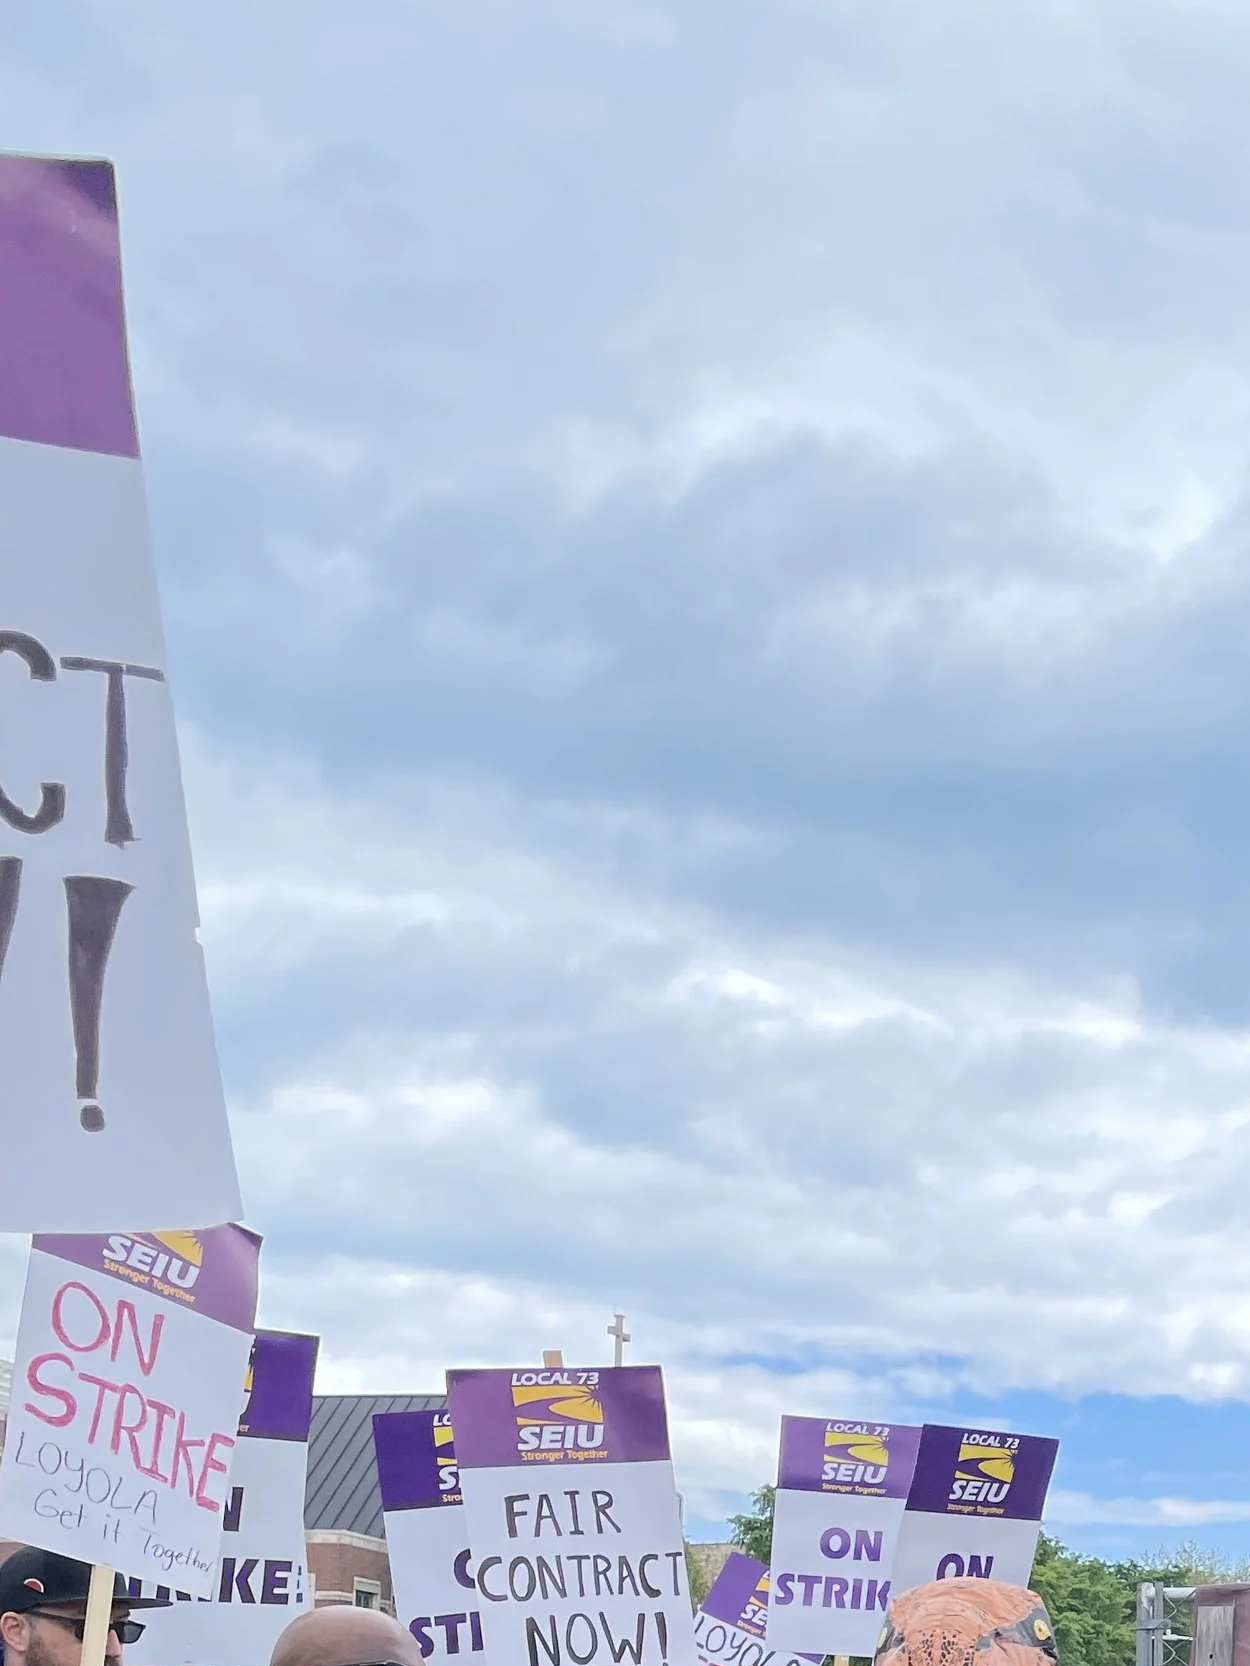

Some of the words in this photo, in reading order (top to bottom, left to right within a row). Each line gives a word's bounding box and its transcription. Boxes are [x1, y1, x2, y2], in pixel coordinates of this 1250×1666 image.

[102, 1234, 200, 1288] SEIU
[103, 1258, 150, 1285] Stronger
[151, 1273, 196, 1303] Together
[51, 1281, 164, 1376] ON
[511, 1372, 572, 1387] LOCAL
[576, 1371, 600, 1386] 73
[24, 1352, 235, 1512] STRIKE
[516, 1423, 605, 1452] SEIU
[826, 1422, 869, 1436] LOCAL
[873, 1425, 890, 1437] 73
[962, 1433, 1001, 1447] LOCAL
[1003, 1437, 1021, 1449] 73
[521, 1450, 565, 1462] Stronger
[566, 1448, 609, 1460] Together
[15, 1431, 158, 1525] LOYOLA
[822, 1462, 888, 1485] SEIU
[948, 1480, 1010, 1503] SEIU
[33, 1488, 82, 1529] Get
[102, 1513, 121, 1544] it
[139, 1527, 213, 1574] Together
[504, 1490, 621, 1538] FAIR
[819, 1527, 884, 1562] ON
[477, 1551, 682, 1602] CONTRACT
[936, 1552, 995, 1581] ON
